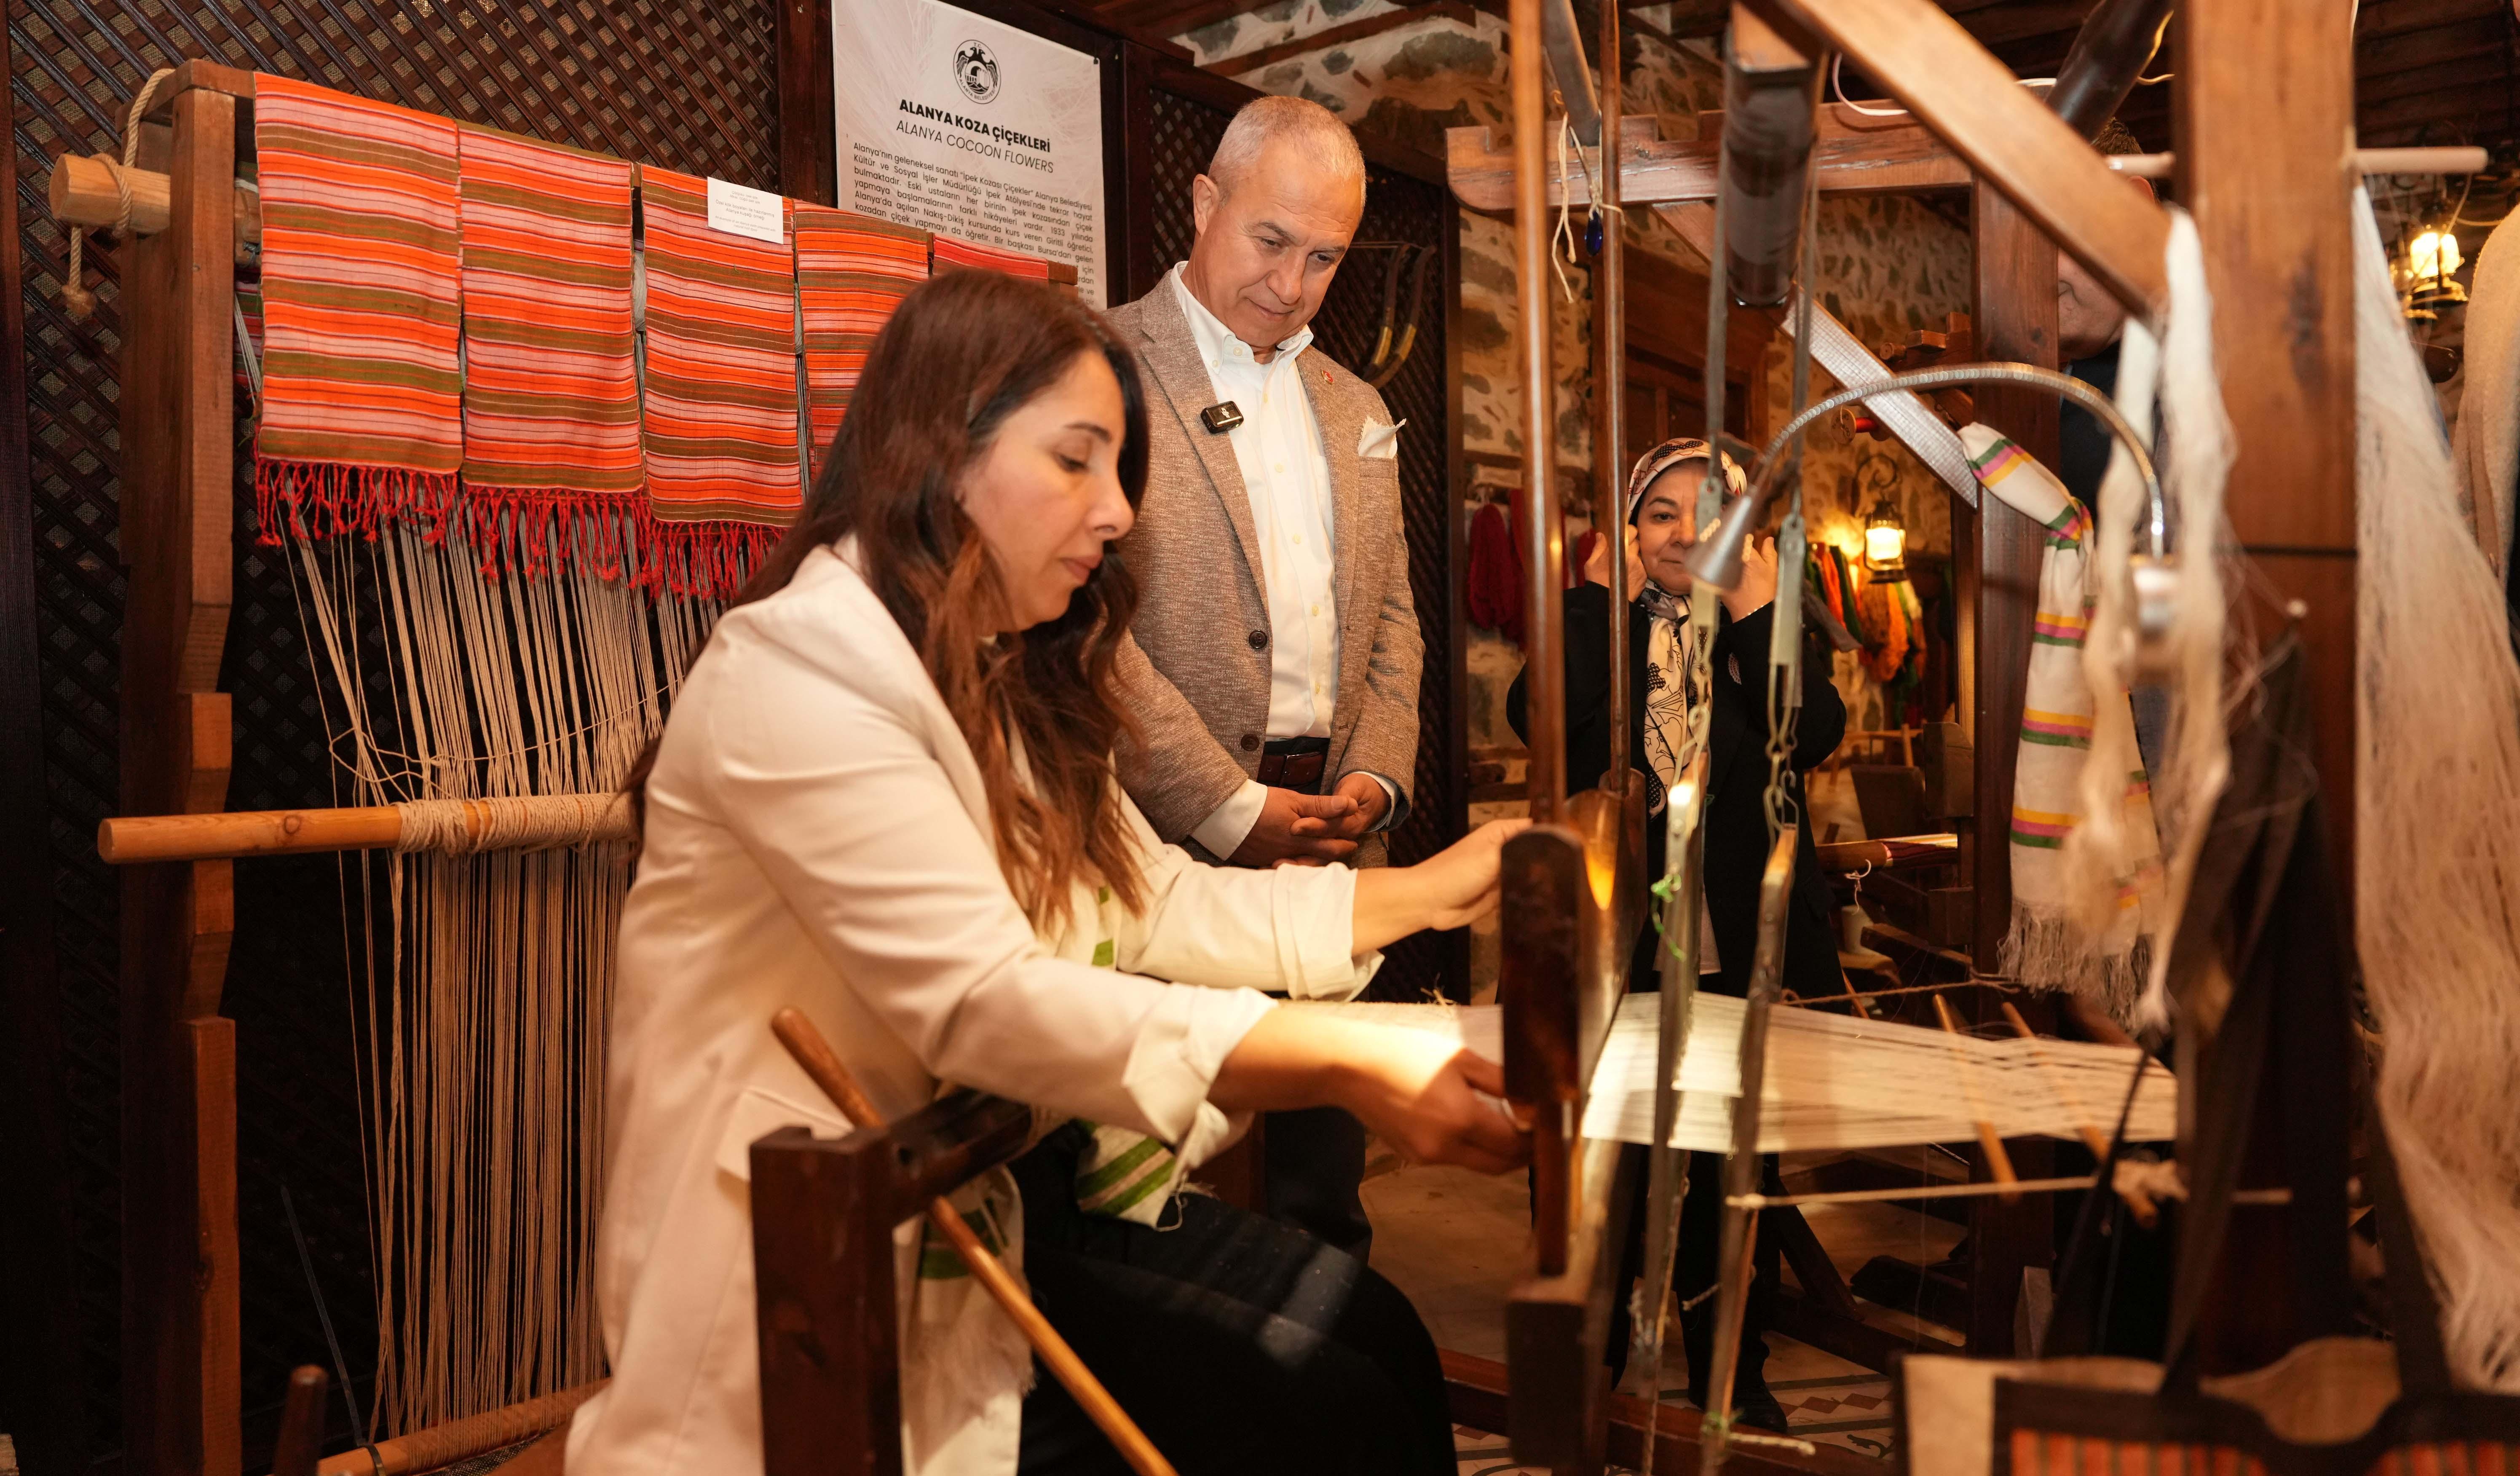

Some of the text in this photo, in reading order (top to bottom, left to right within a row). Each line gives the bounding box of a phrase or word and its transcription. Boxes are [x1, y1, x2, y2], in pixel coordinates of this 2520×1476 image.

[959, 79, 973, 97] ALANYA
[896, 120, 1053, 173] ALANYA COCOON FLOWERS
[900, 99, 1050, 153] ALANYA KOZA ÇİÇEKLERİ
[854, 142, 892, 160] Alanya'nın
[894, 156, 933, 171] geleneksel
[936, 166, 958, 177] sanatı
[980, 177, 1002, 189] Kozası
[1035, 191, 1058, 204] Alanya
[1060, 197, 1092, 211] Belediyesi
[854, 154, 875, 166] Kültür
[894, 166, 918, 179] Sosyal
[923, 171, 938, 183] İşler
[943, 179, 981, 196] Müdürlüğü
[1050, 206, 1069, 216] tekrar
[1074, 211, 1092, 221] hayat
[854, 166, 1092, 232] bulmaktadır. Eski ustaların her birinin ipek kozasından çiçek
[855, 179, 890, 195] yapmaya
[897, 190, 953, 210] başlamalarının
[960, 205, 977, 216] farklı
[1024, 222, 1044, 232] vardır.
[1051, 227, 1065, 236] 1933
[1071, 233, 1093, 242] yılında
[855, 190, 892, 207] Alanya'da
[897, 202, 919, 214] açılan
[969, 219, 1001, 233] kursunda
[1006, 227, 1020, 237] kurs
[1024, 233, 1042, 242] veren
[1047, 237, 1063, 246] Giritli
[855, 202, 1093, 263] kozadan çiçek yapmayı da öğretir. Bir başkası Bursa'dan gelen
[1082, 265, 1094, 275] için
